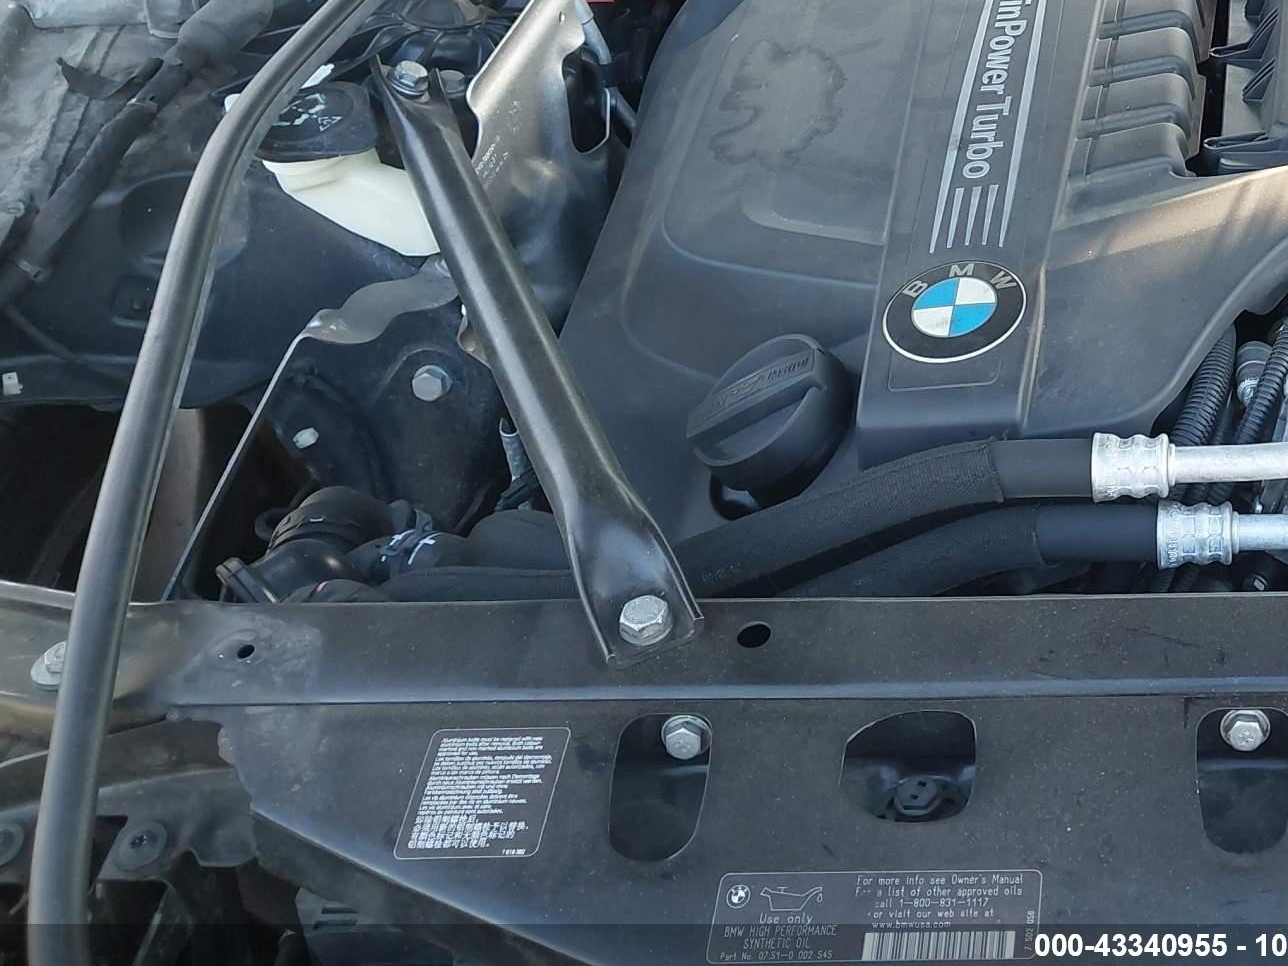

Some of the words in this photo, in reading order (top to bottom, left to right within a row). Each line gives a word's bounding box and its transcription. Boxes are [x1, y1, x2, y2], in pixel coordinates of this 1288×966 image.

[968, 95, 1014, 181] Turbo
[902, 263, 1017, 298] BMW
[856, 875, 873, 885] For
[951, 875, 986, 884] Owner's
[992, 874, 1023, 884] Manual
[910, 886, 921, 896] of
[926, 886, 951, 896] other
[957, 886, 999, 896] approved
[760, 914, 780, 924] Use
[788, 913, 814, 926] only
[937, 909, 954, 918] web
[724, 926, 744, 938] BMW
[749, 925, 770, 937] HIGH
[775, 925, 838, 936] PERFORMANCE
[744, 938, 791, 950] SYNTHETIC
[796, 938, 810, 948] OIL
[720, 952, 737, 961] Part
